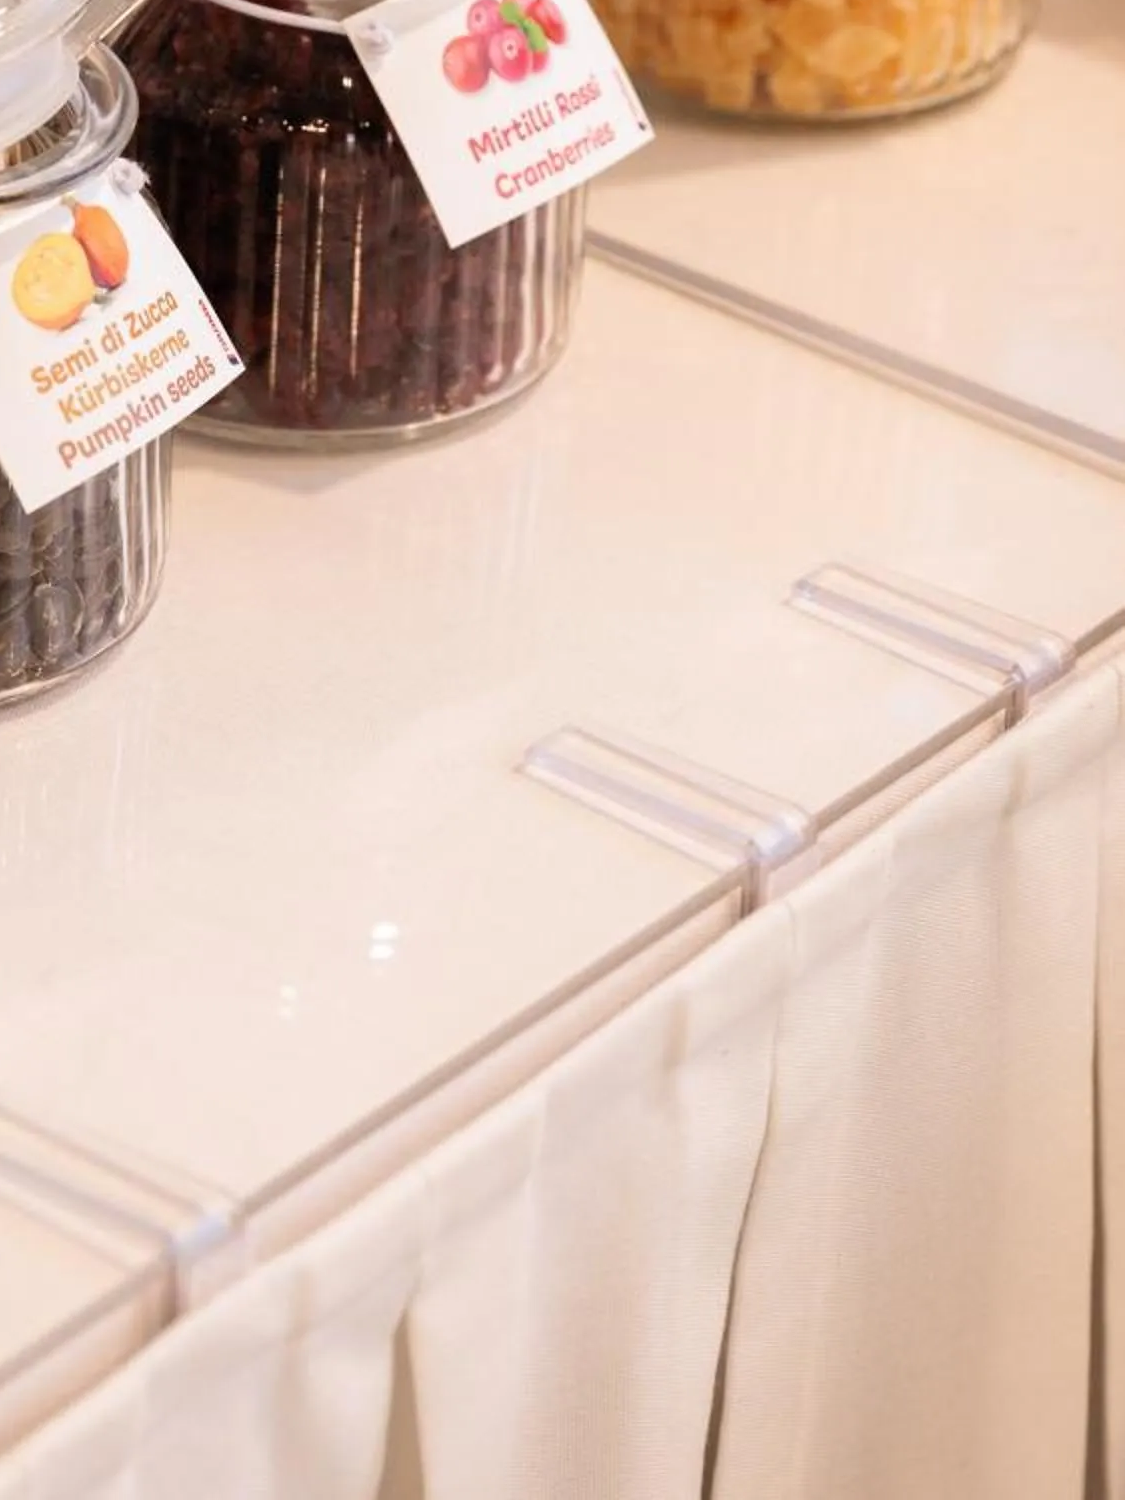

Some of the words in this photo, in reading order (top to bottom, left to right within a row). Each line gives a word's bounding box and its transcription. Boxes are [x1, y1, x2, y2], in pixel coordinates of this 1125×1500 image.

[467, 100, 554, 163] Mirtilli
[557, 73, 601, 119] Rossi
[494, 122, 615, 199] Cranberries
[30, 338, 99, 395] Semi
[101, 324, 124, 355] di
[124, 291, 178, 339] Zucca
[57, 327, 191, 424] Kürbiskerne
[58, 391, 168, 469] Pumpkin
[167, 354, 216, 402] seeds
